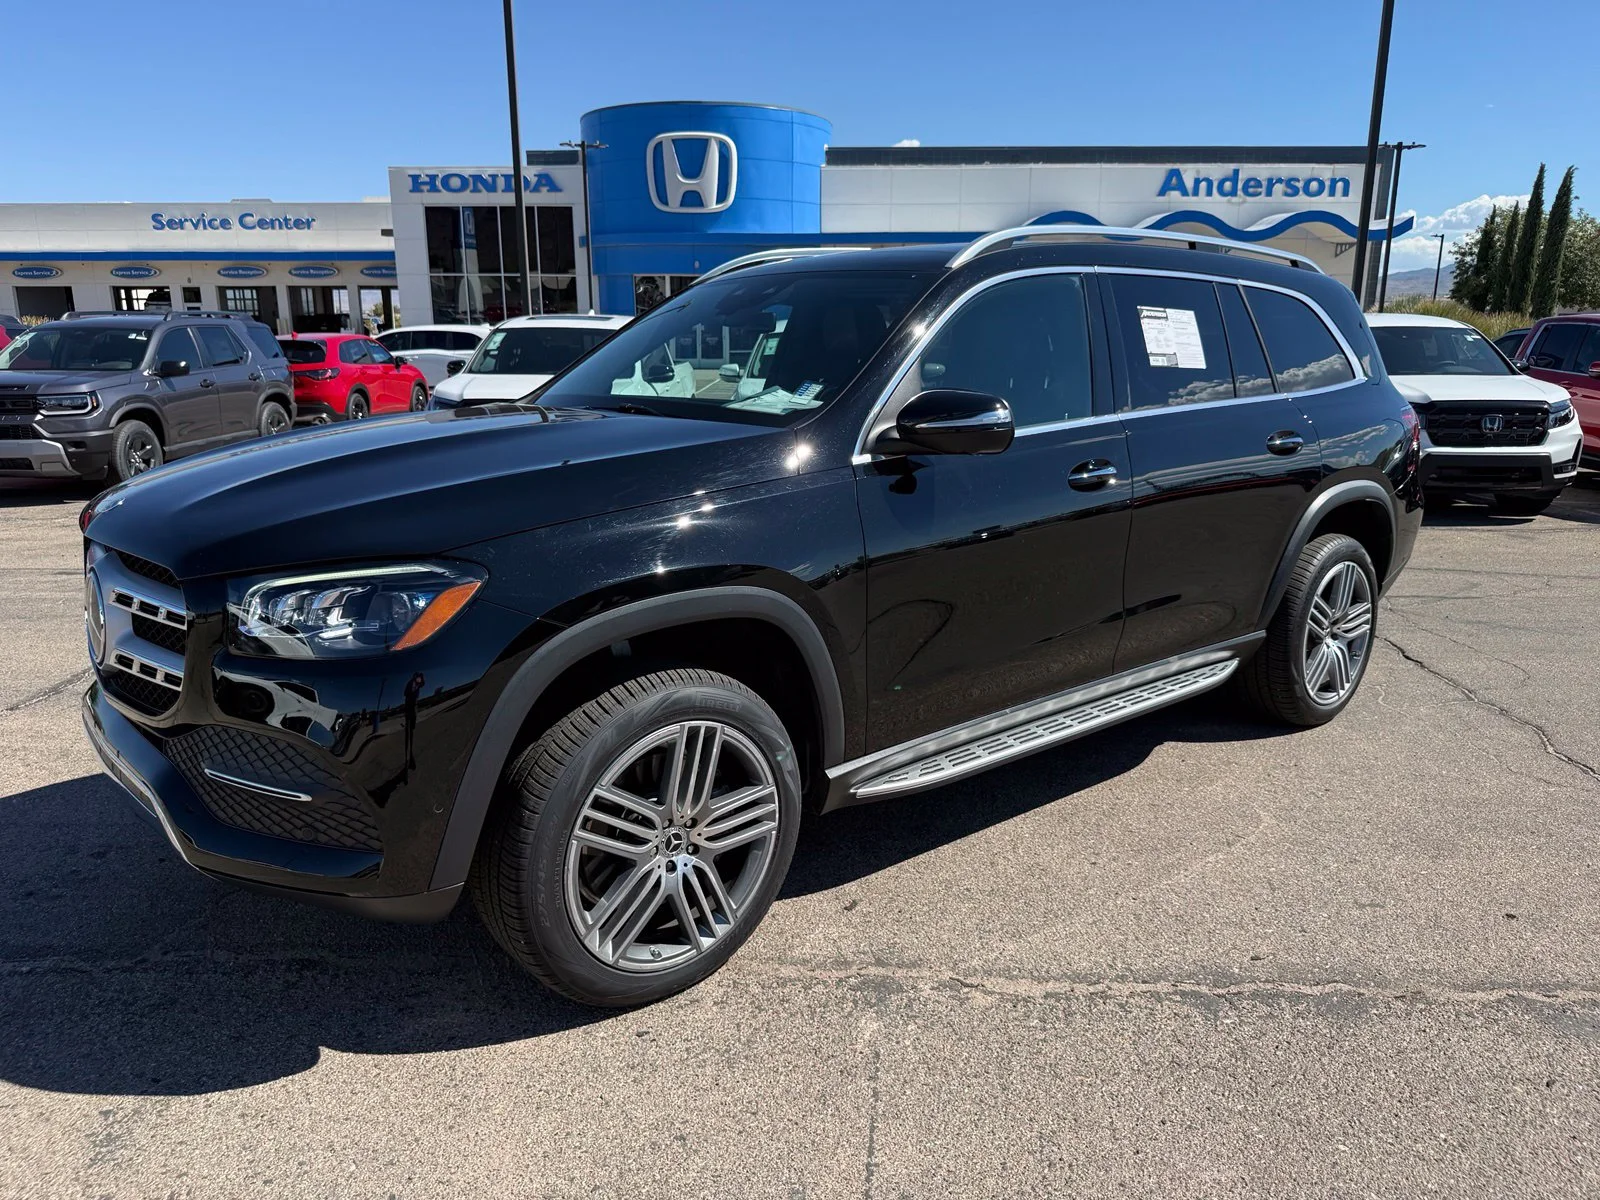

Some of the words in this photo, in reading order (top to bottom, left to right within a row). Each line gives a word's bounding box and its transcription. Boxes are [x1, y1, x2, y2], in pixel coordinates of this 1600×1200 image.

[408, 173, 563, 193] HONDA
[1156, 168, 1350, 198] Anderson
[151, 212, 233, 231] Service
[238, 212, 316, 231] Center
